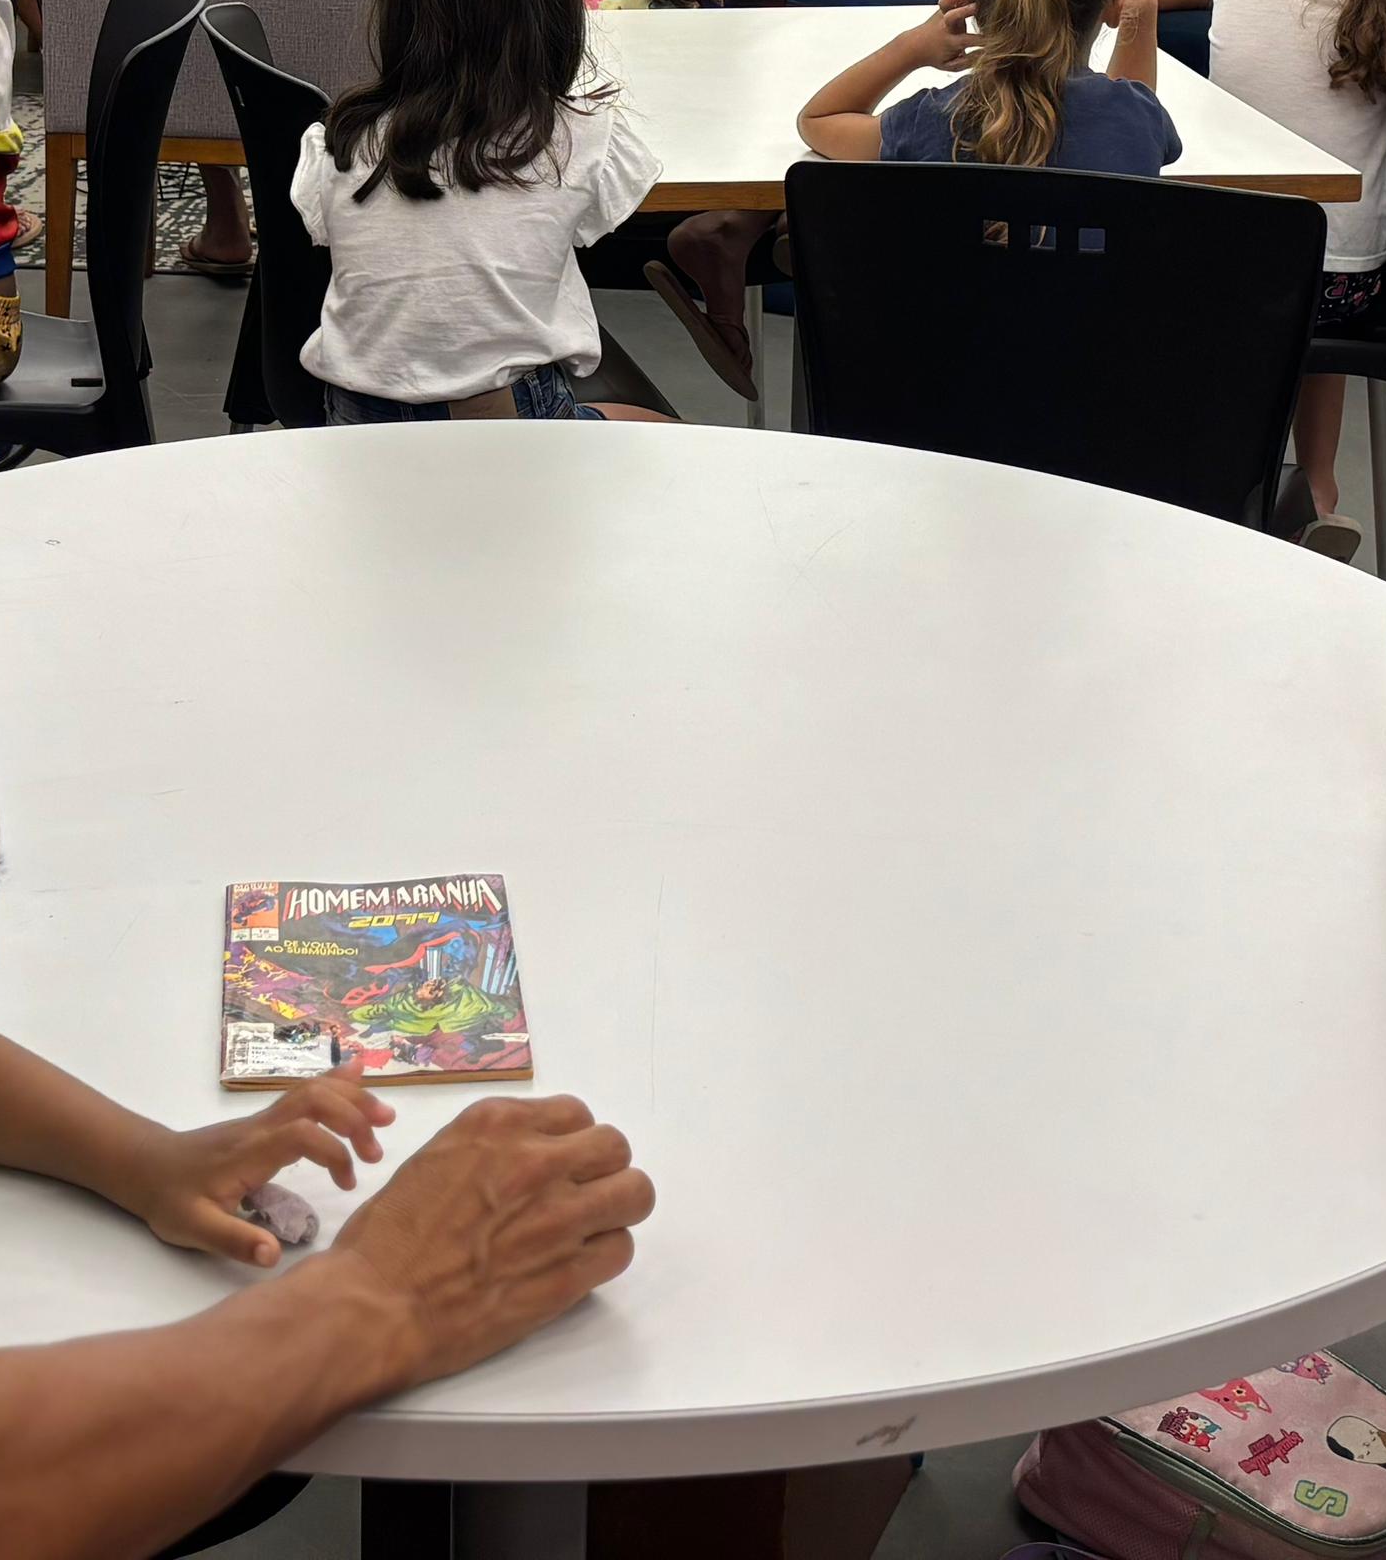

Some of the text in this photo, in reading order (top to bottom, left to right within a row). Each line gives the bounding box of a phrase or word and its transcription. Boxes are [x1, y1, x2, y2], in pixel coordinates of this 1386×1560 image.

[283, 940, 339, 949] DE VOLTA
[264, 945, 283, 953] AO
